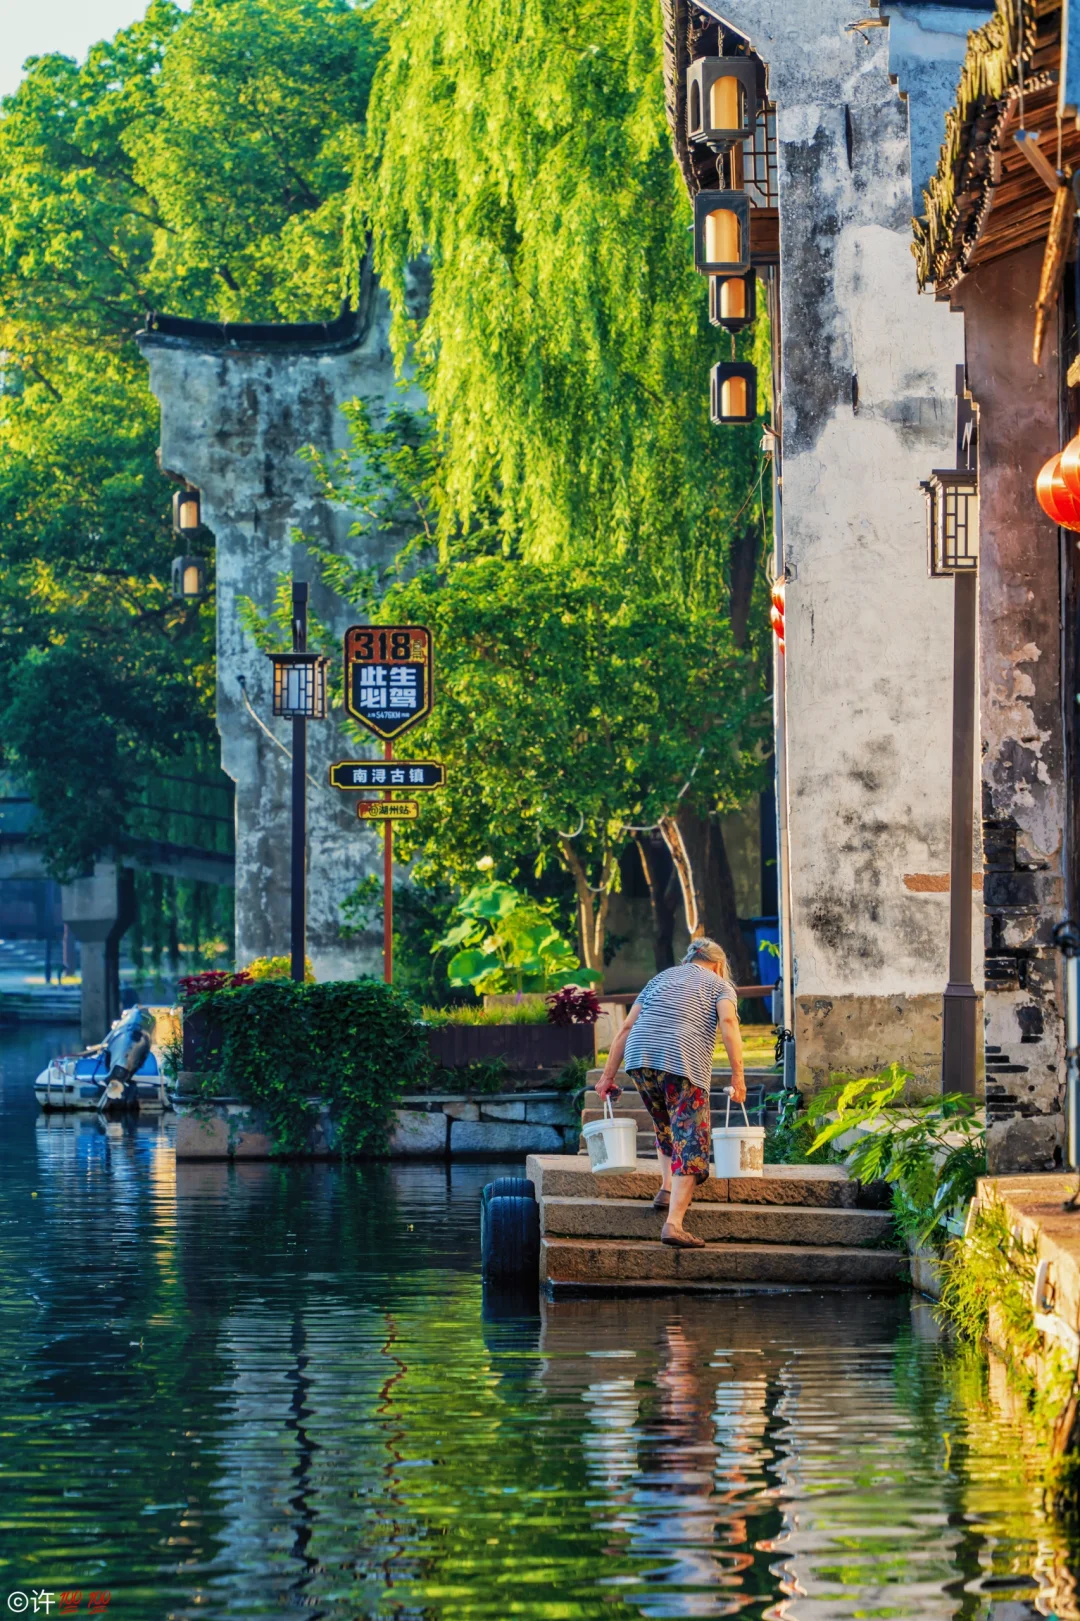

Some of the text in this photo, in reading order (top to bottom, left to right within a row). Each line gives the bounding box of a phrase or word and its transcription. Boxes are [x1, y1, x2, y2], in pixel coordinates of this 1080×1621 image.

[354, 632, 411, 660] 318
[360, 666, 417, 687] 此生
[360, 687, 417, 709] 必驾
[352, 768, 425, 783] 南浔古镇
